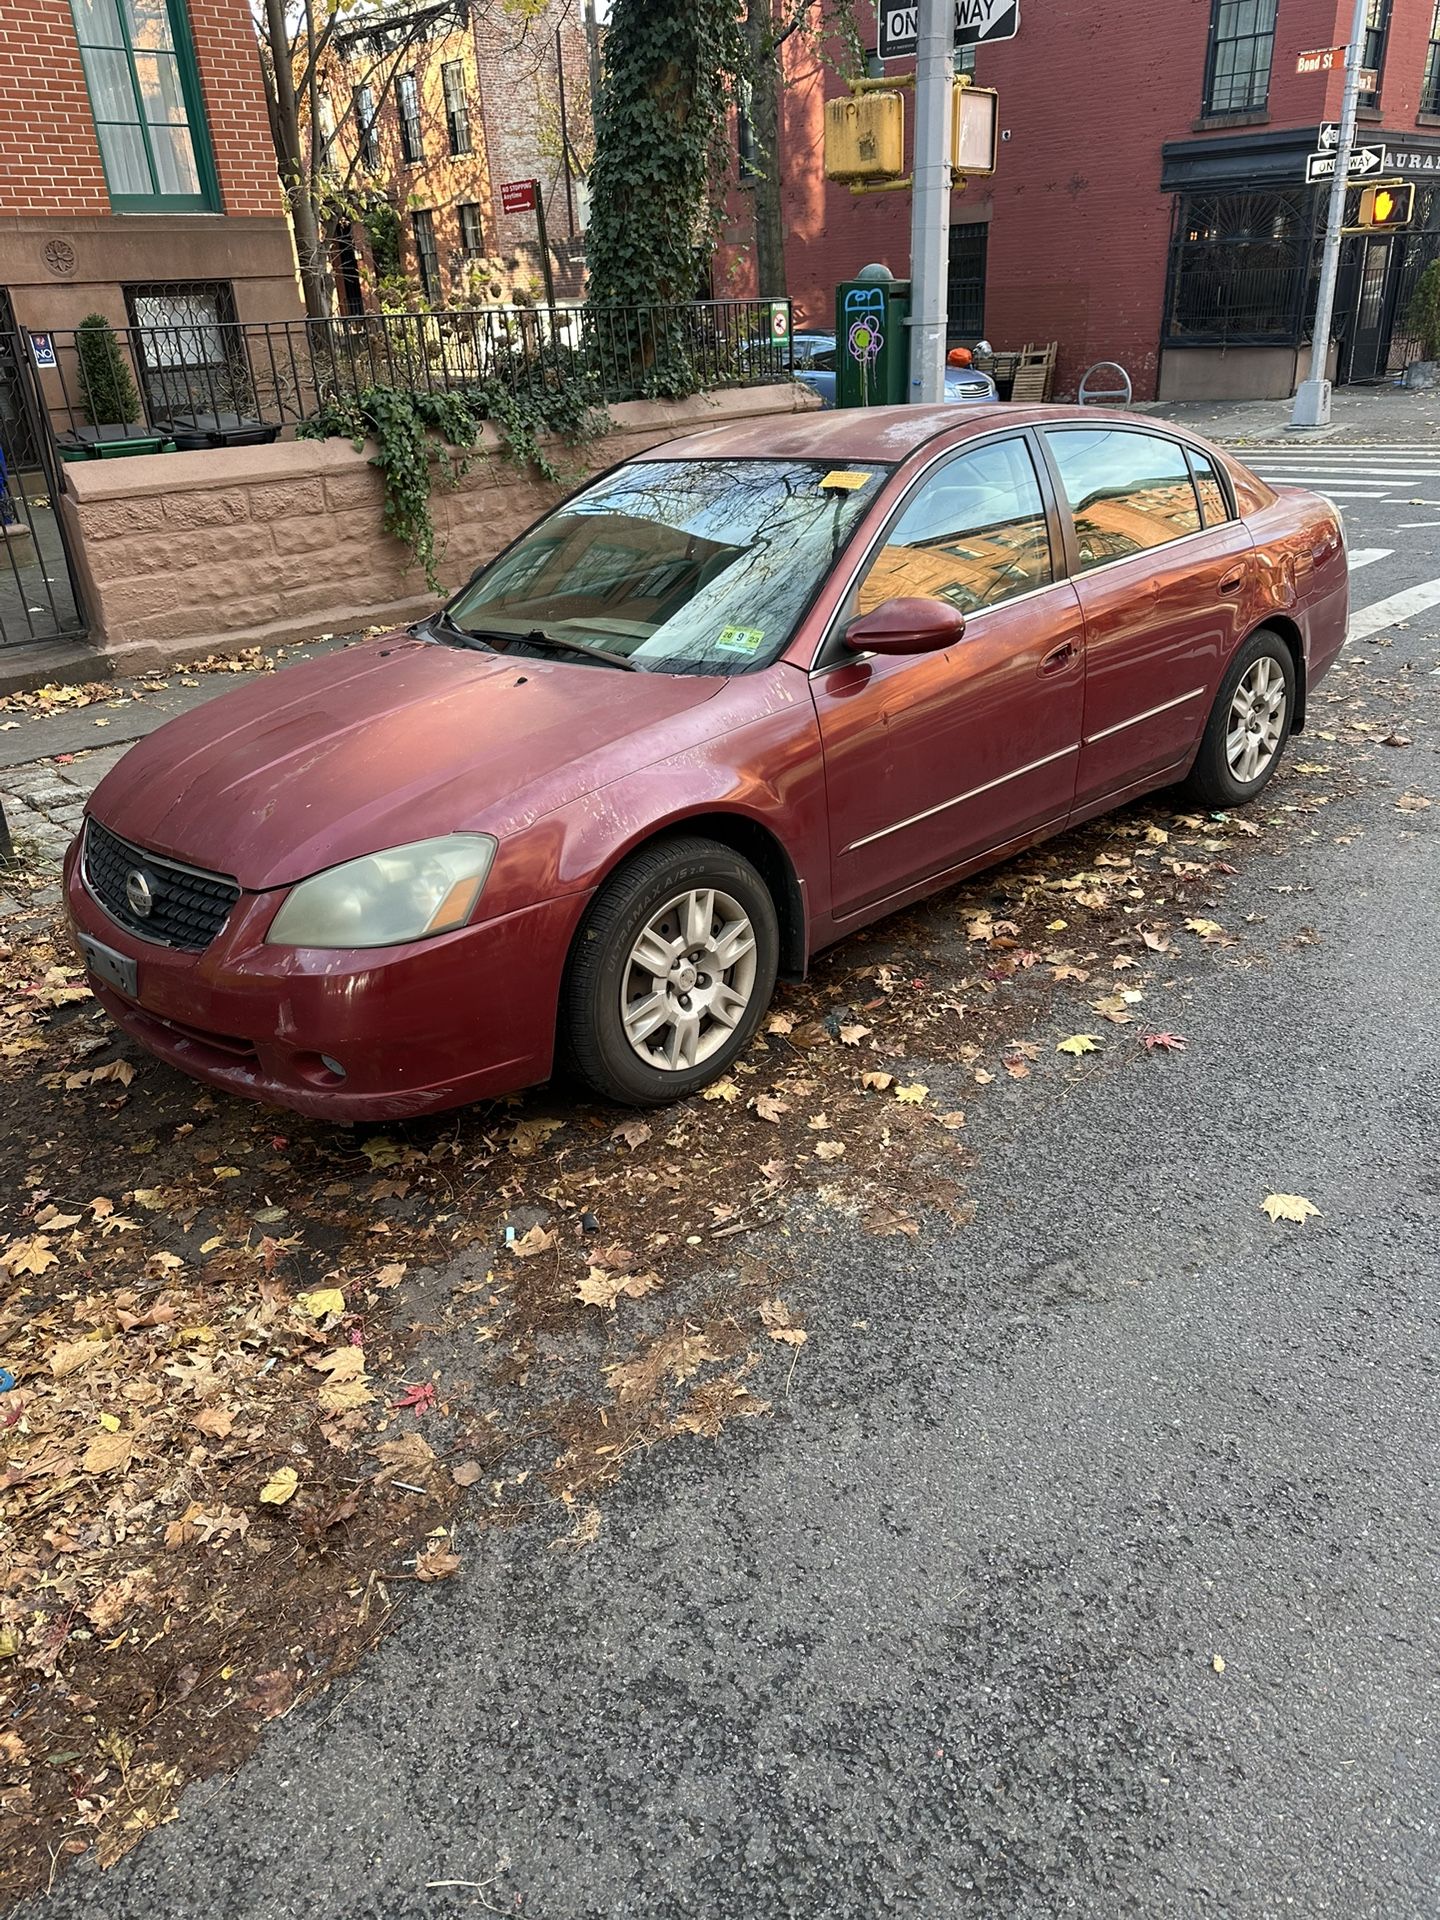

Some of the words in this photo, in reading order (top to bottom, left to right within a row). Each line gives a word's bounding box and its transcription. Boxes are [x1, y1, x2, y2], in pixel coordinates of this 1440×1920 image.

[891, 10, 918, 37] ON
[954, 0, 995, 26] WAY
[1297, 55, 1321, 72] Bond
[1322, 53, 1334, 69] St
[1319, 161, 1334, 172] ON
[1350, 156, 1372, 169] WAY
[502, 185, 509, 193] NO
[509, 181, 532, 192] STOPPING
[503, 192, 523, 200] Anytime
[35, 348, 52, 359] NO
[723, 631, 733, 639] 20
[736, 632, 745, 642] 9
[749, 636, 760, 644] 23
